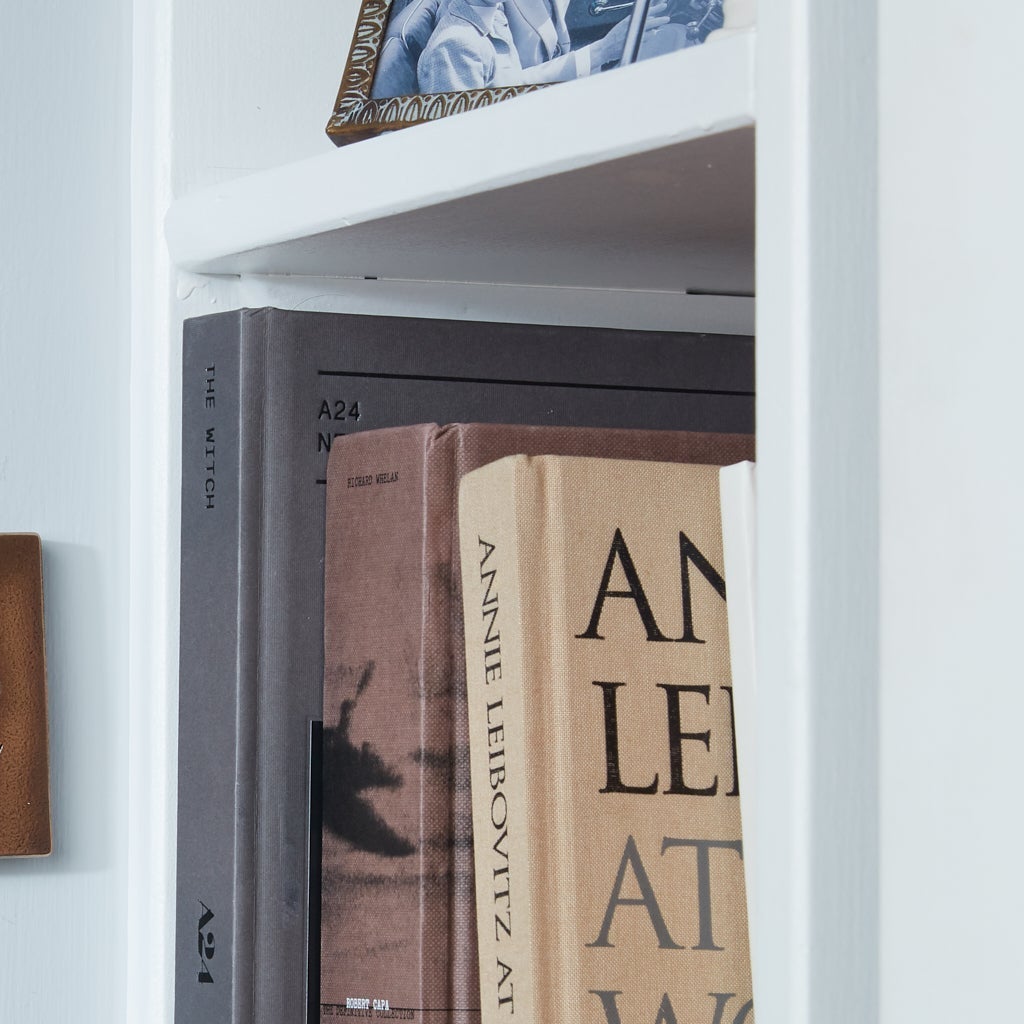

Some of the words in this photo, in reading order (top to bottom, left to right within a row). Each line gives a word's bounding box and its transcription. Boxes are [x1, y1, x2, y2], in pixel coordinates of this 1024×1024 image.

[205, 363, 216, 409] THE
[318, 399, 361, 422] A24
[205, 427, 216, 509] WITCH
[318, 432, 346, 453] N
[347, 474, 373, 489] RICHARD
[376, 471, 399, 484] WHELAN
[477, 535, 503, 685] ANNIE
[486, 697, 512, 942] LEIBOVITZ
[584, 834, 744, 951] AT
[198, 898, 216, 984] A24
[346, 997, 370, 1009] ROBERT
[373, 998, 390, 1011] CAPA
[497, 957, 515, 1015] AT
